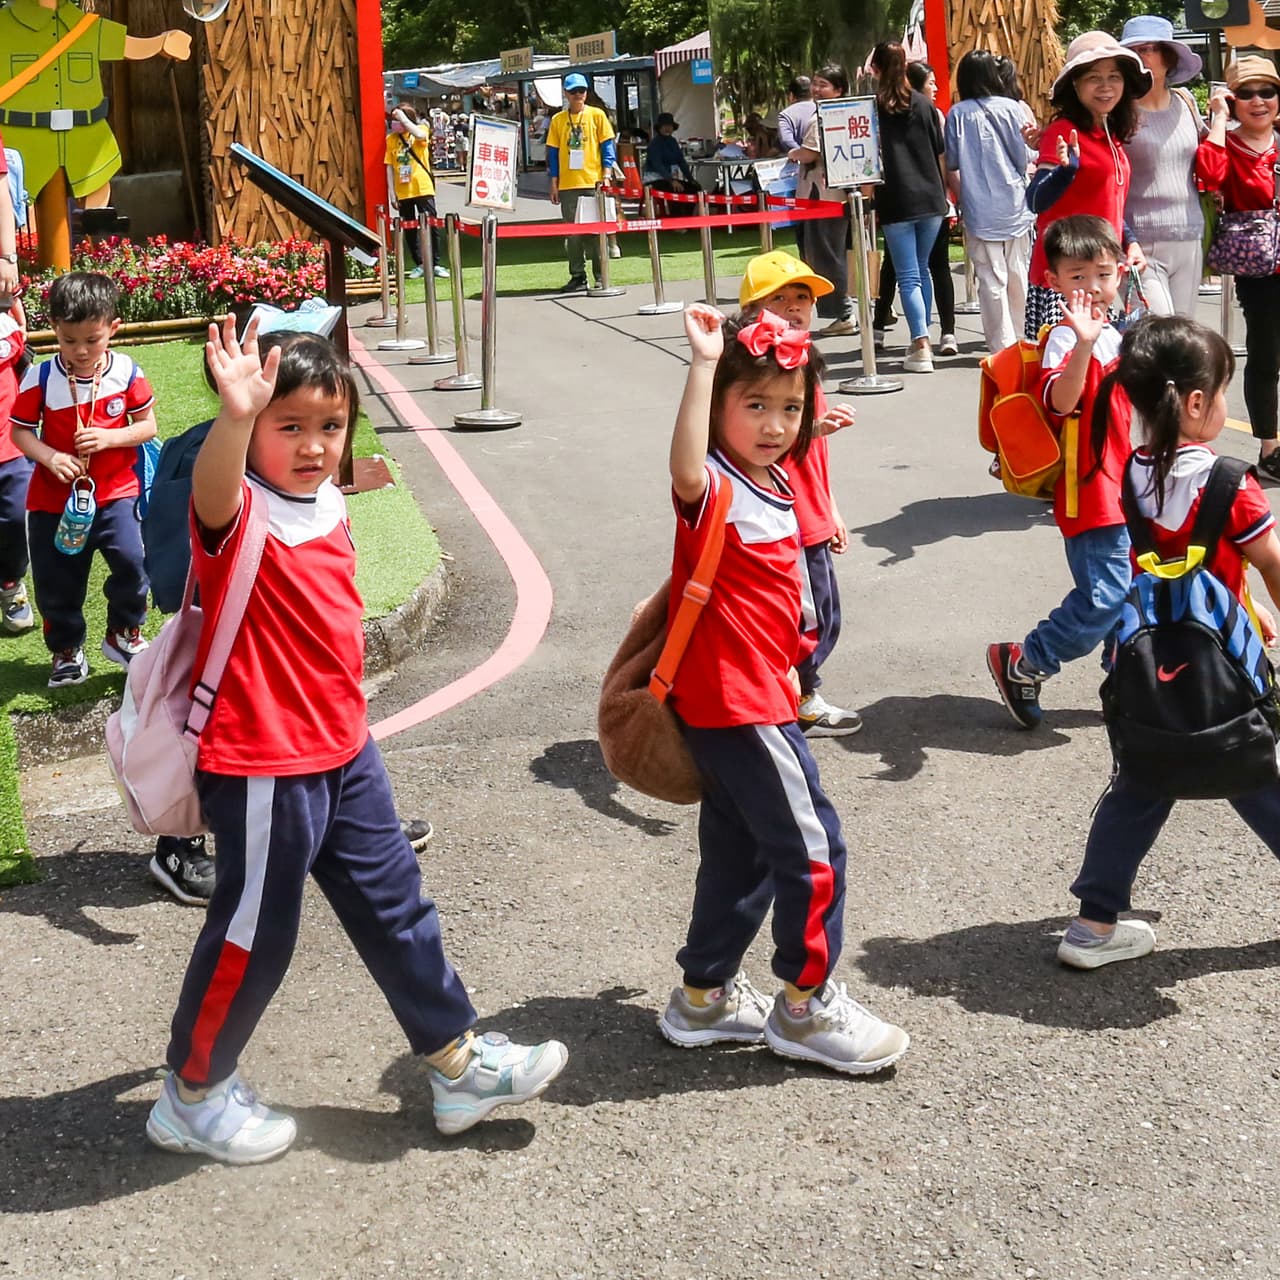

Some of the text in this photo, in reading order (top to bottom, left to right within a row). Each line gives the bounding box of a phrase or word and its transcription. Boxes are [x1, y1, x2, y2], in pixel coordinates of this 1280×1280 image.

[825, 115, 870, 139] 一般
[477, 142, 509, 166] 車輛
[833, 143, 865, 163] 入口
